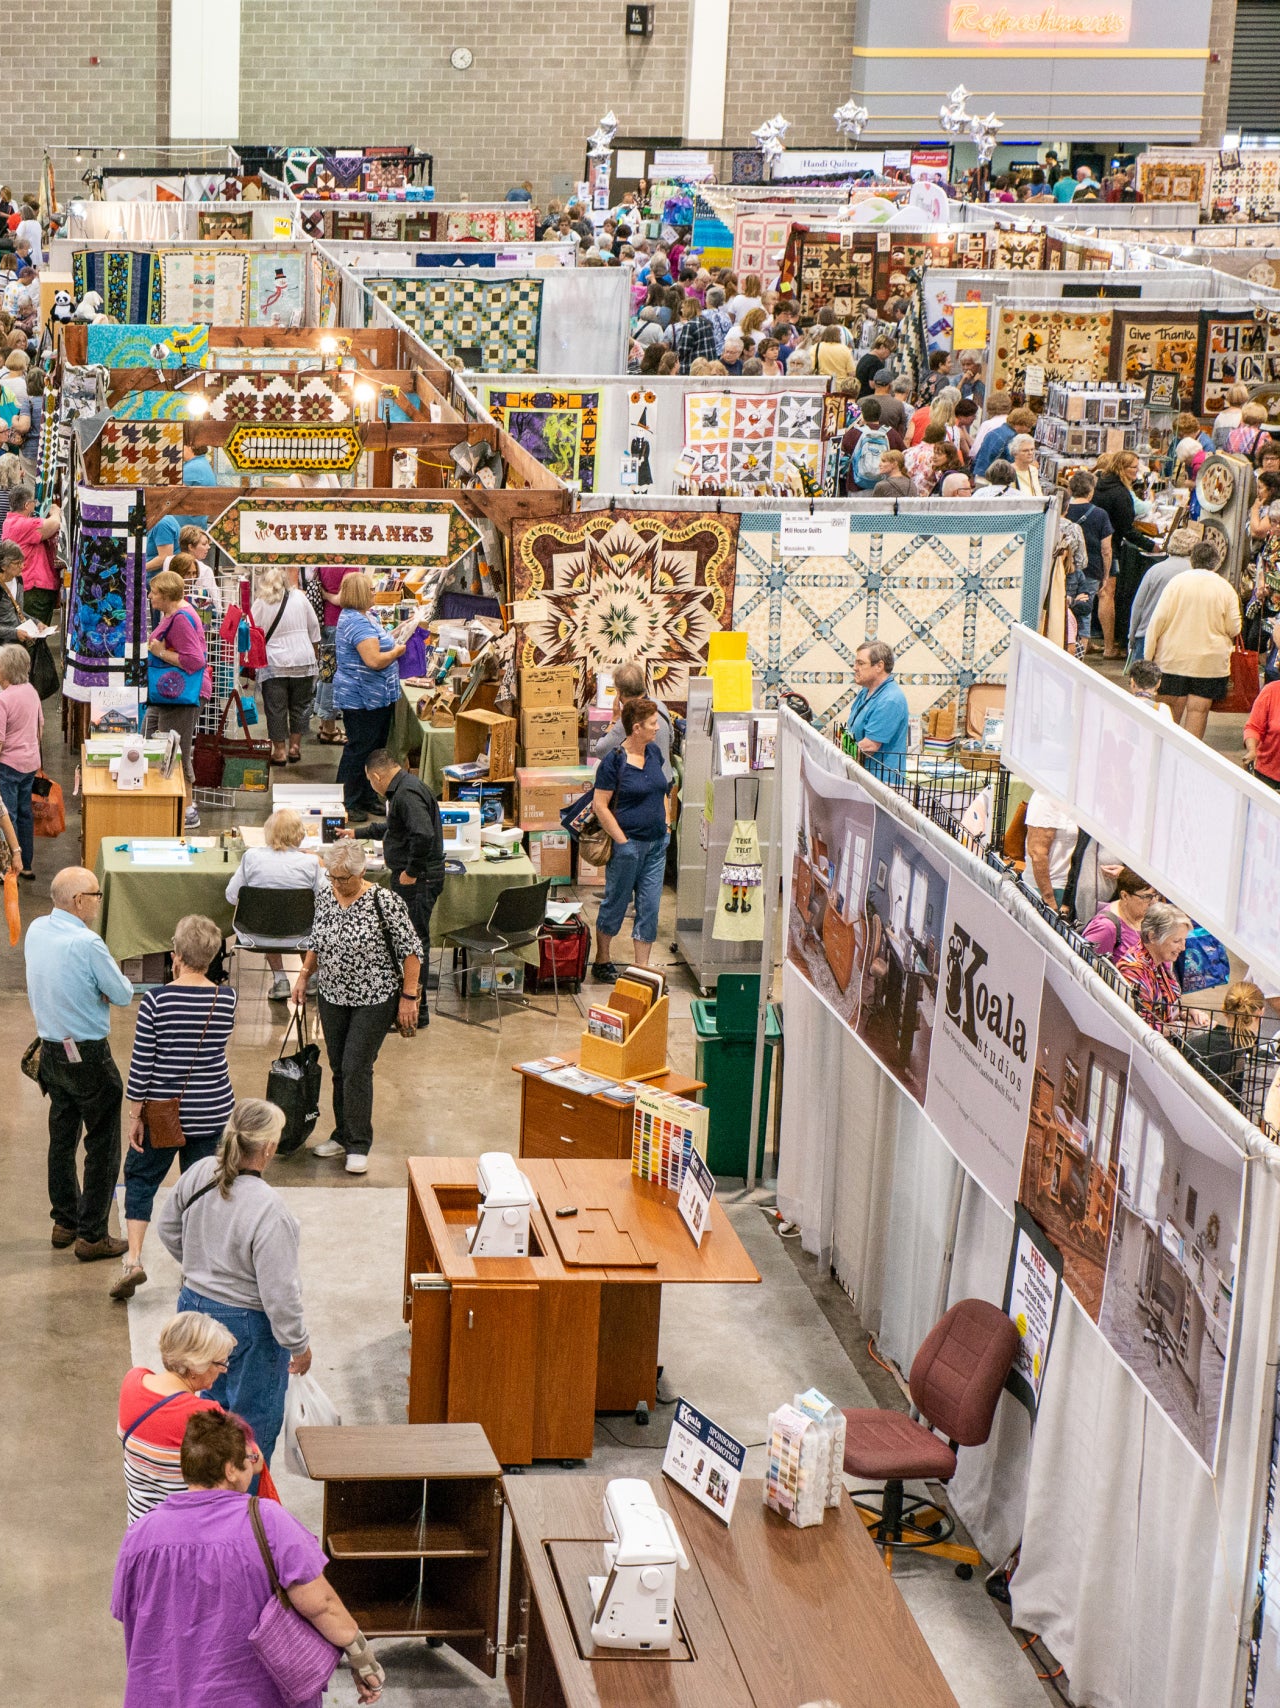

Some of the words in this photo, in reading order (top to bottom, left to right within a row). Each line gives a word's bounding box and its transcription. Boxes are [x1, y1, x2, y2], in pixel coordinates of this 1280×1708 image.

[953, 4, 1125, 40] Refreshments
[803, 160, 827, 168] Handi
[829, 160, 858, 169] Quilter
[1129, 327, 1151, 340] Give
[1155, 326, 1197, 340] Thanks
[273, 524, 327, 541] GIVE
[334, 524, 434, 543] THANKS
[945, 922, 1027, 1063] Koala
[977, 1037, 1022, 1092] studios
[1030, 1244, 1047, 1279] FREE
[707, 1436, 740, 1467] PROMOTION
[708, 1426, 740, 1455] SPONSORED
